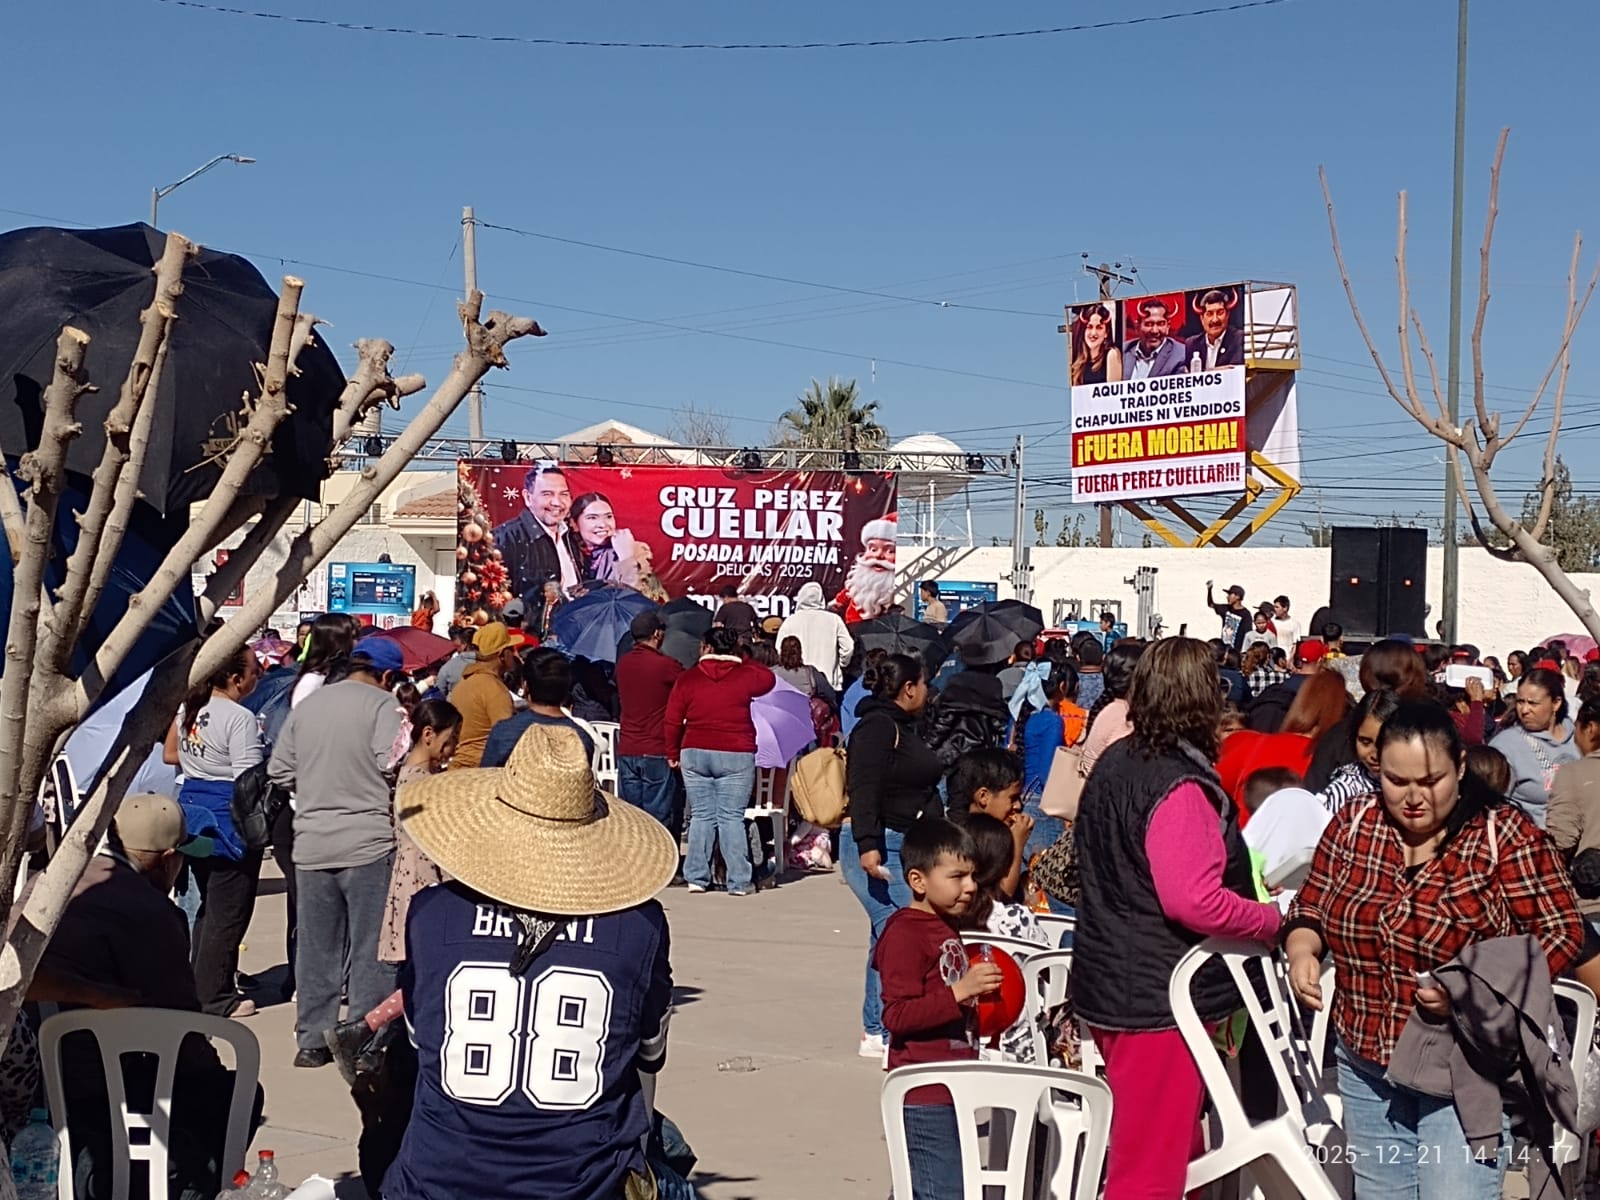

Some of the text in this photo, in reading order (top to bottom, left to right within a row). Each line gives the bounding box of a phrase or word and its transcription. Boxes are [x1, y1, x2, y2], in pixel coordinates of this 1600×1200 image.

[1092, 373, 1222, 399] AQUI NO QUEREMOS
[1120, 391, 1193, 410] TRAIDORES
[1075, 400, 1241, 428] CHAPULINES NI VENDIDOS
[1077, 421, 1238, 466] ¡FUERA MORENA!
[1077, 462, 1241, 494] FUERA PEREZ CUELLAR!!!
[659, 483, 844, 512] CRUZ PÉREZ
[660, 507, 844, 541] CUELLAR
[671, 542, 839, 564] POSADA NAVIDEÑA
[716, 563, 813, 578] DELICIAS 2025
[471, 904, 600, 945] BRNT
[440, 961, 615, 1110] 88
